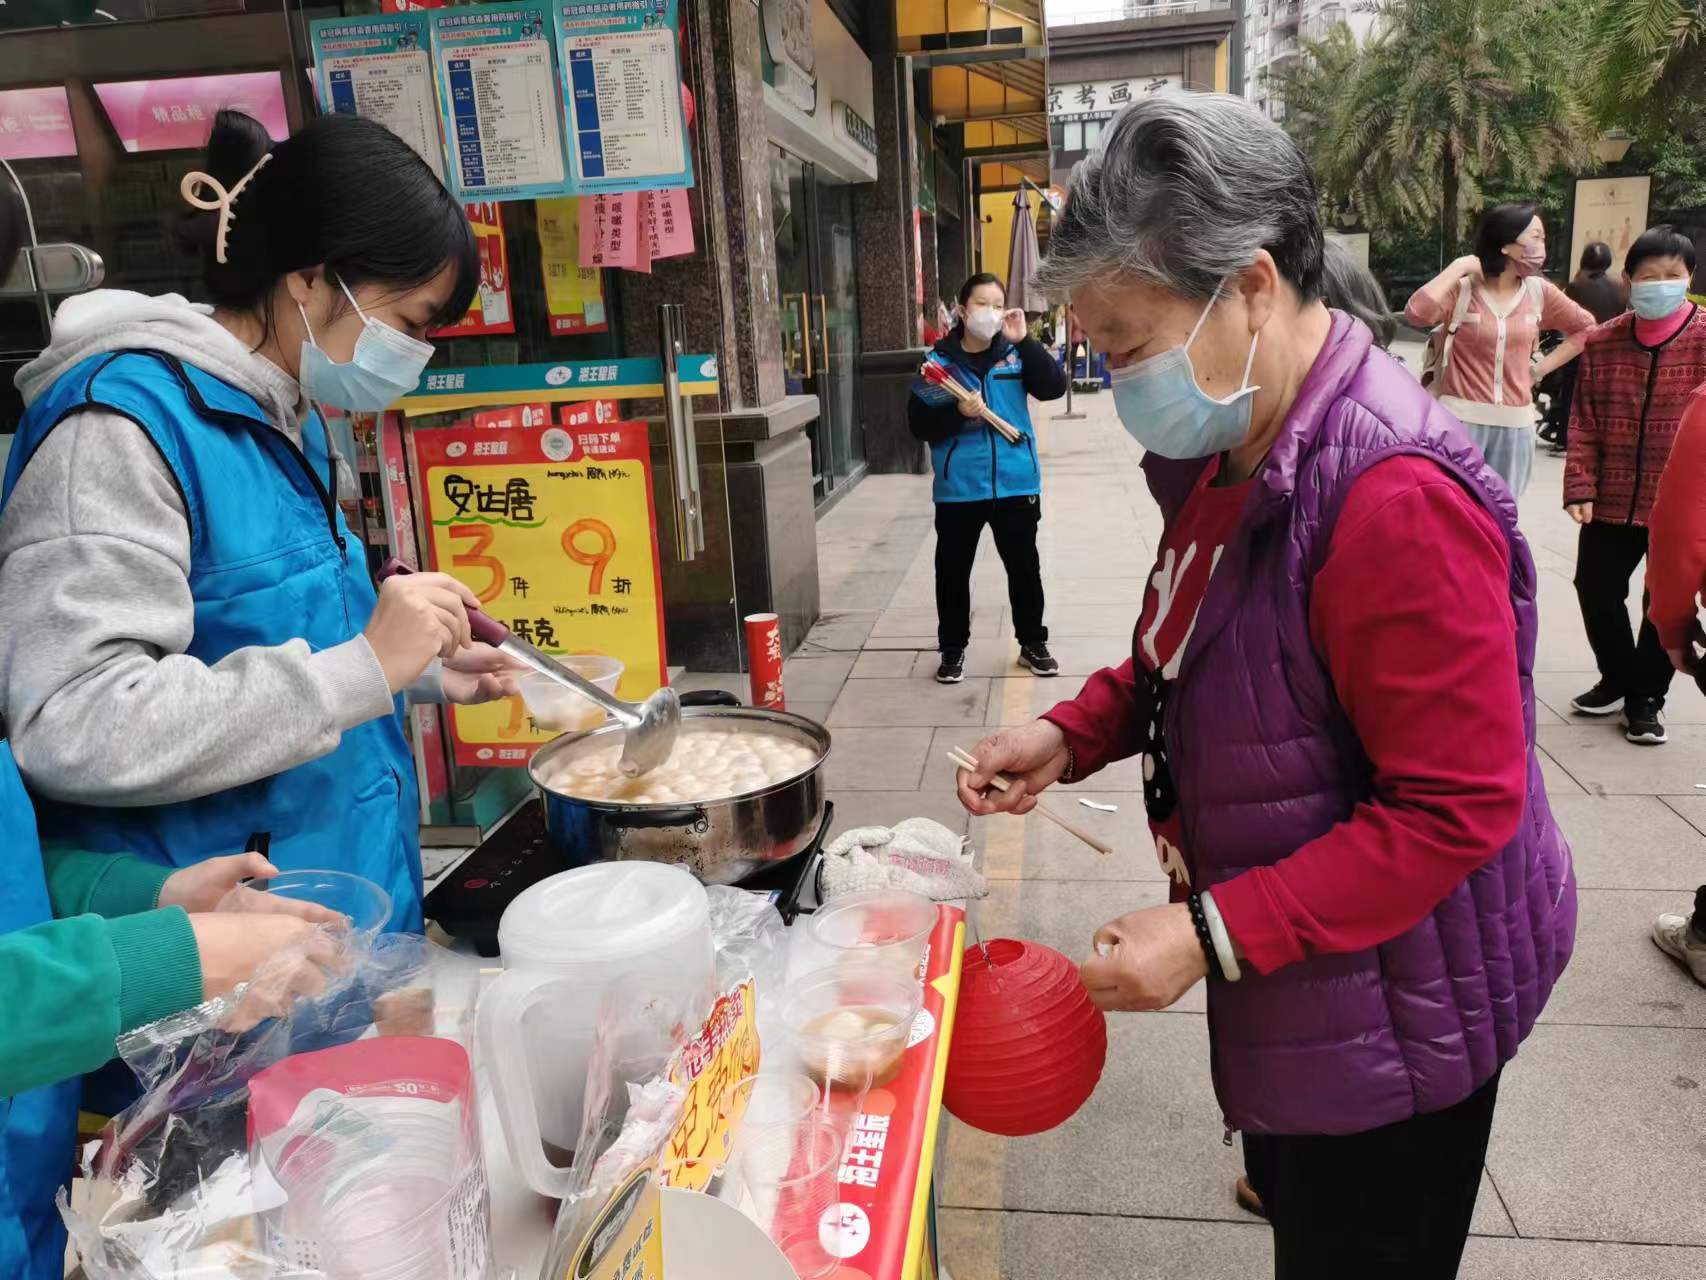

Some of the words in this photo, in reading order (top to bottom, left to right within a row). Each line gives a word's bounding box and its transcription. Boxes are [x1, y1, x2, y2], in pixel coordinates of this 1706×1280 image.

[510, 576, 530, 600] 件
[561, 518, 617, 595] 9
[611, 577, 633, 595] 折
